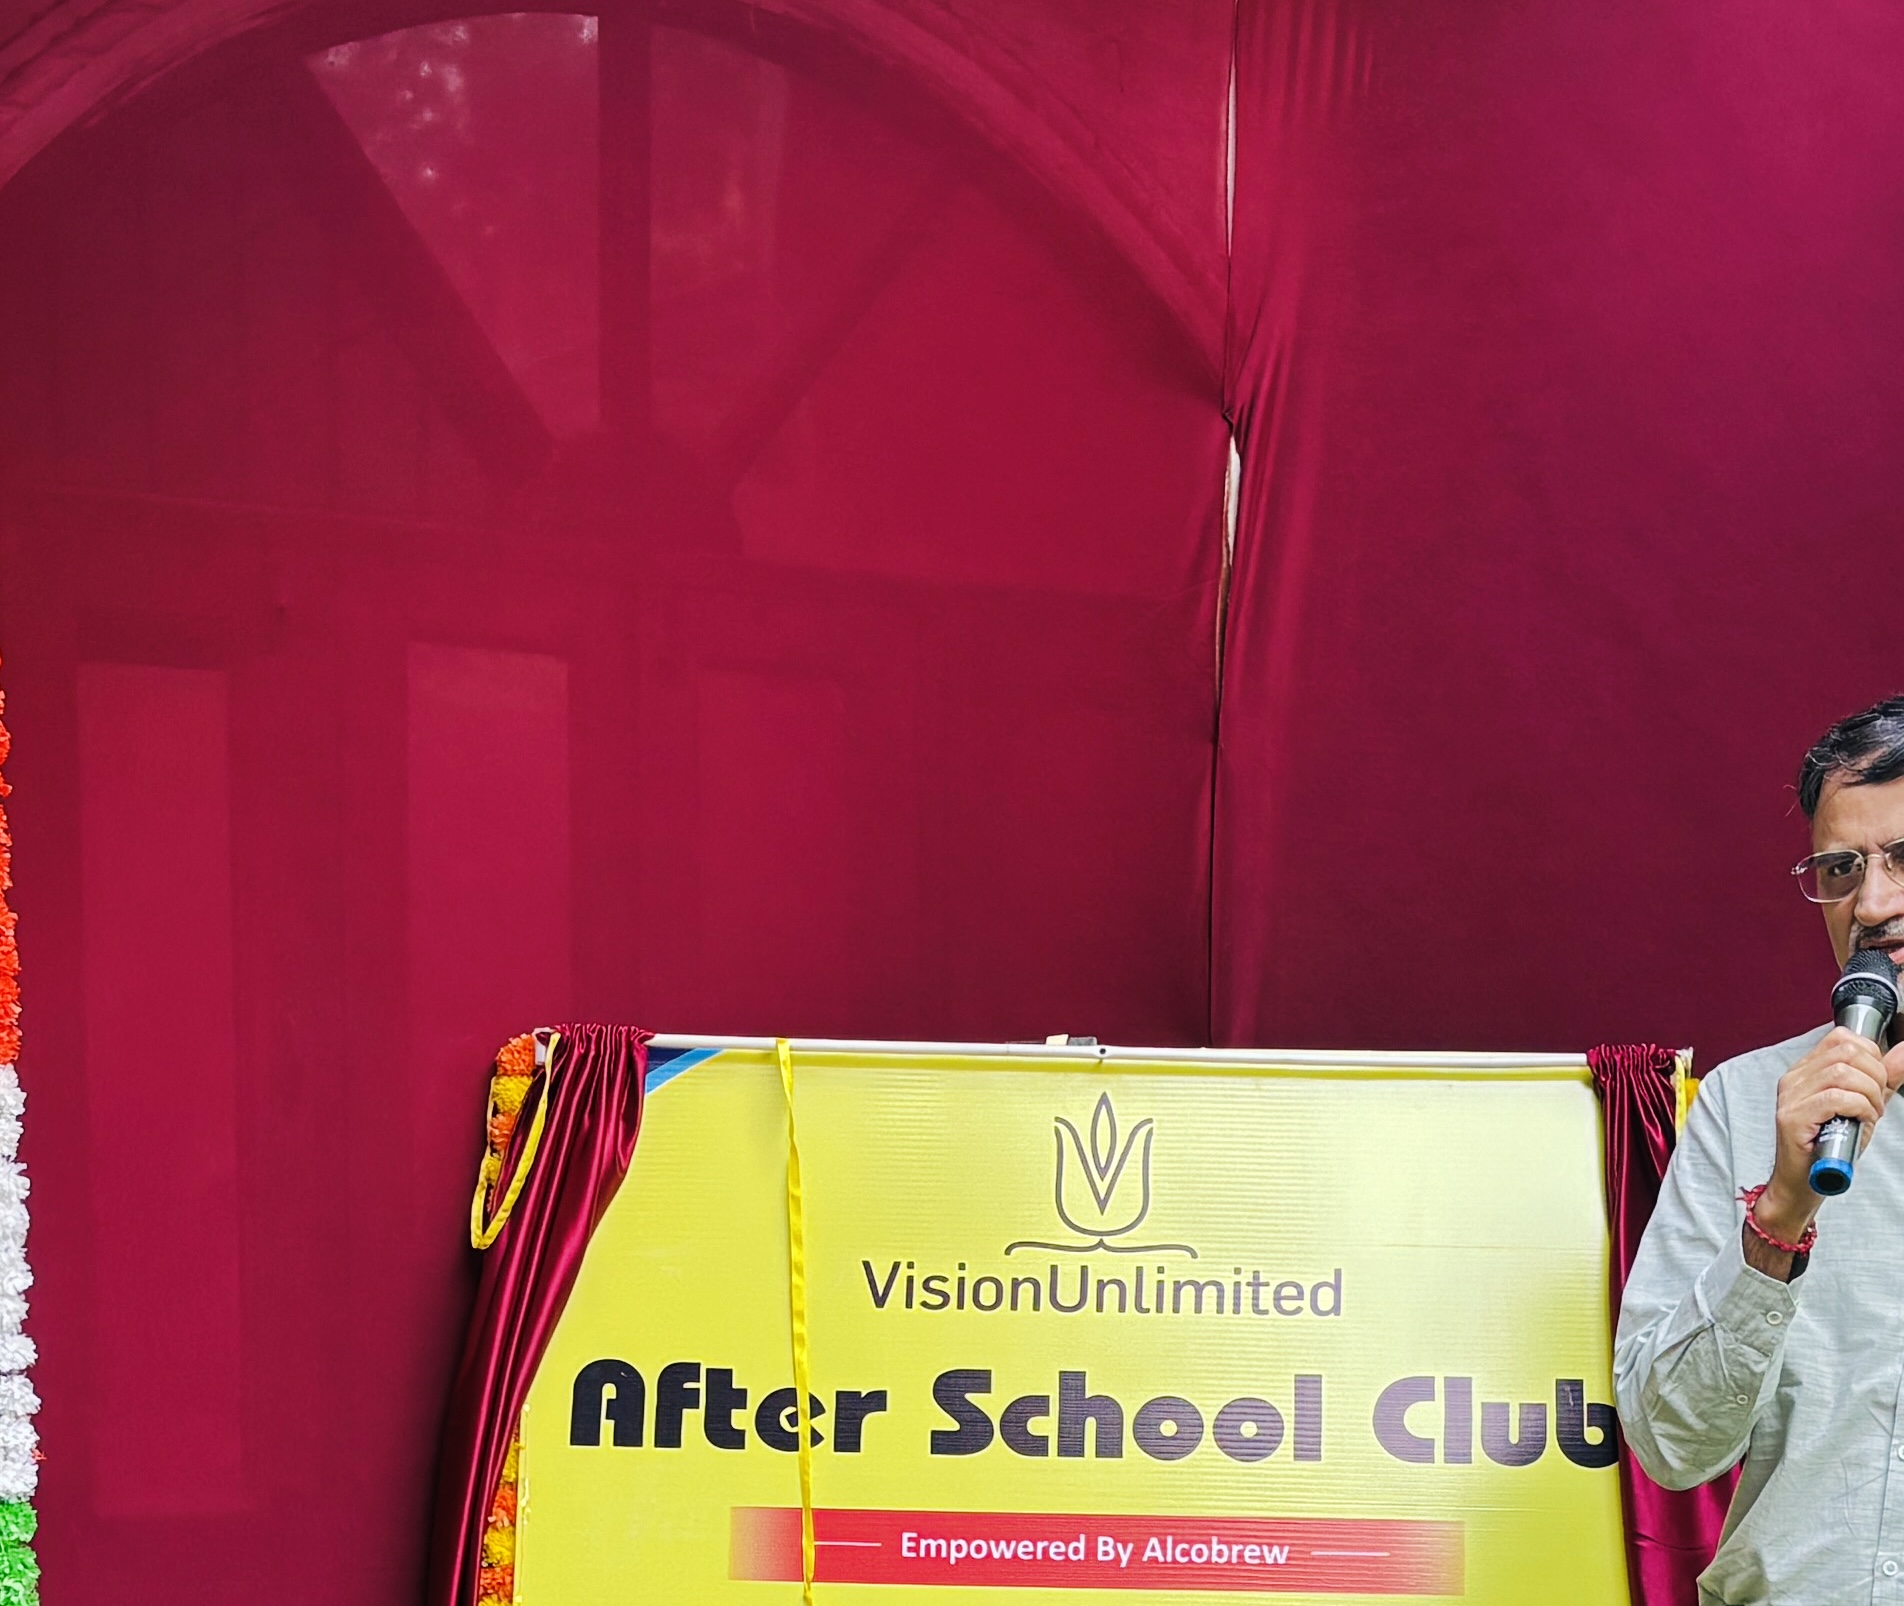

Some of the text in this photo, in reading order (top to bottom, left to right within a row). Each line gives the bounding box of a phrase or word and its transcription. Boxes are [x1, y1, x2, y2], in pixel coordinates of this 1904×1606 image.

[861, 1259, 1343, 1317] VisionUnlimited
[569, 1359, 1620, 1469] After School Club
[900, 1531, 1290, 1568] Empowered By Alcobrew
